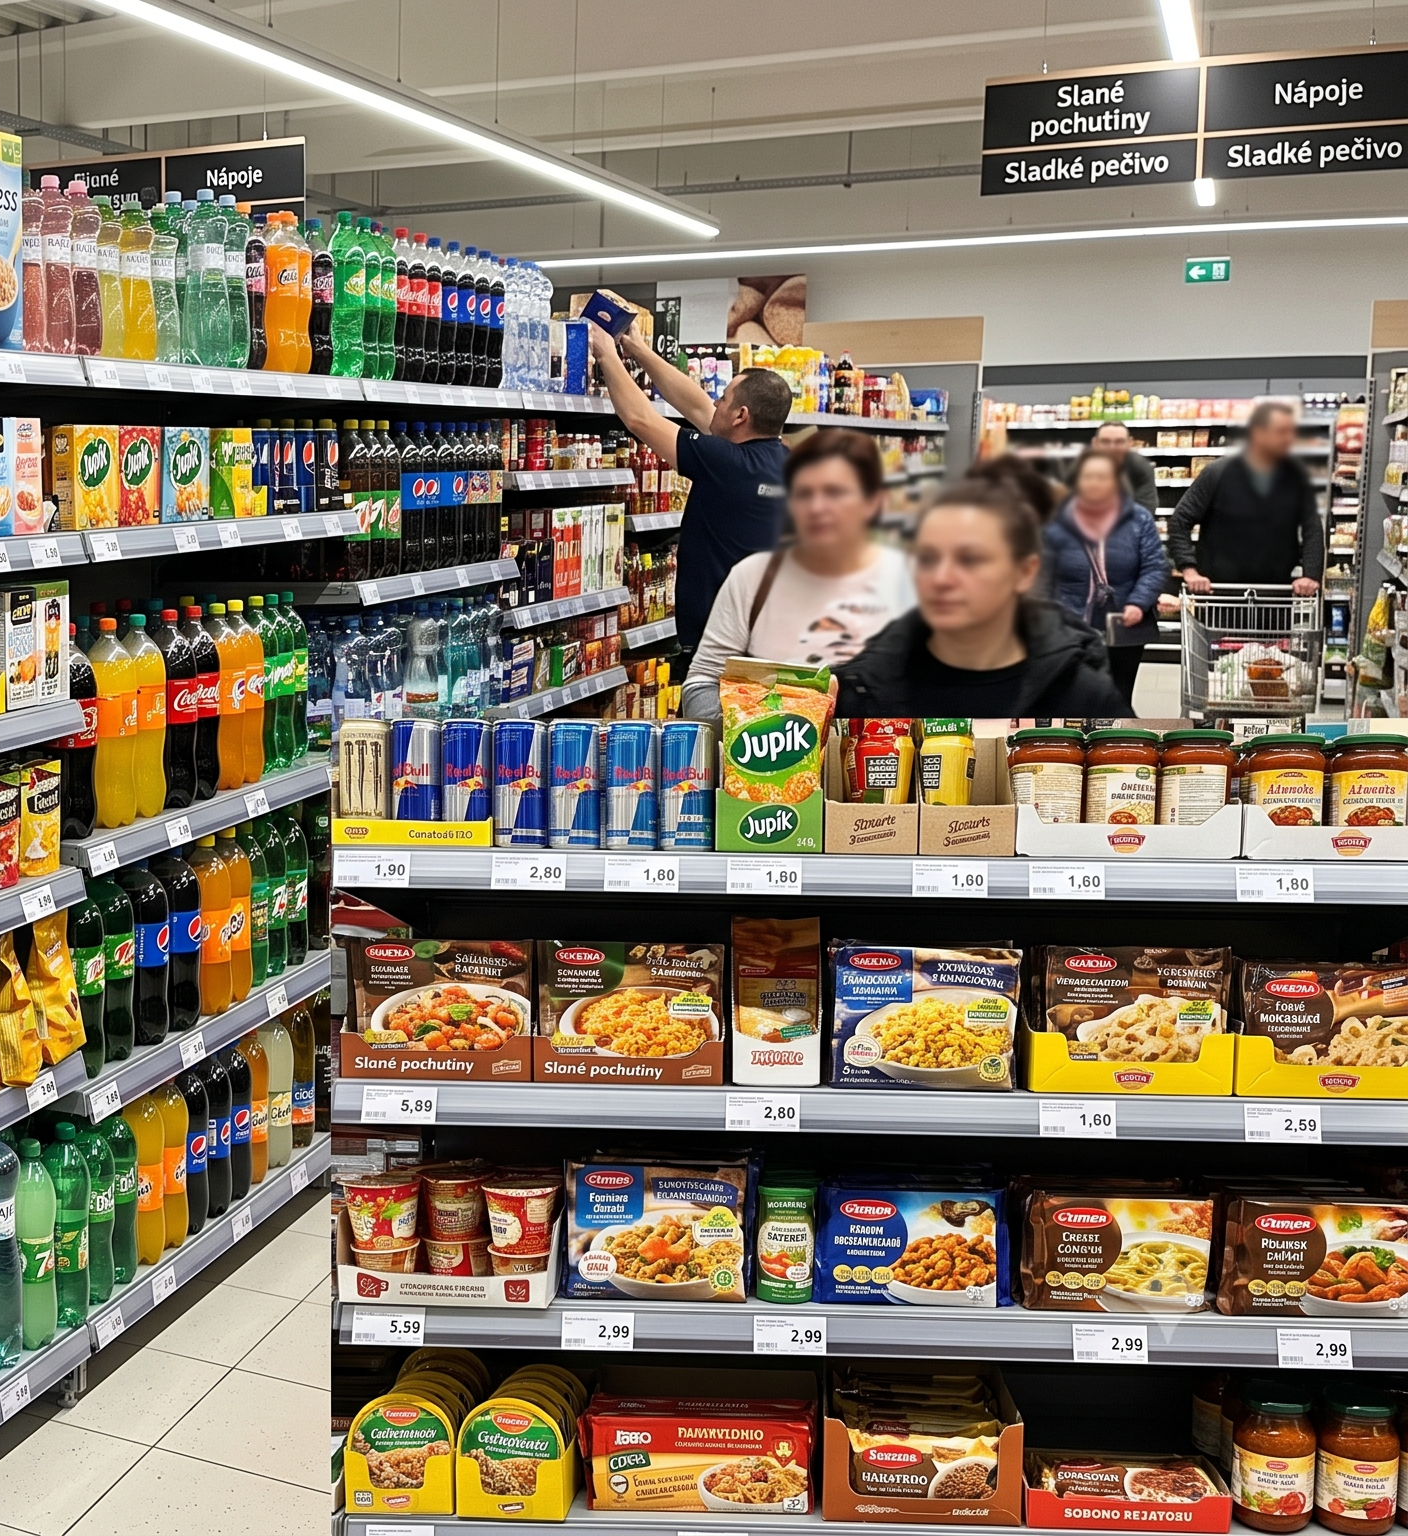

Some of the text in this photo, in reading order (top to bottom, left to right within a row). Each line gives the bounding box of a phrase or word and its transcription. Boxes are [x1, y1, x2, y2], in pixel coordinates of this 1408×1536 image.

[1057, 80, 1124, 107] Slané
[1274, 78, 1363, 108] Nápoje
[1030, 110, 1150, 142] pochutiny
[1227, 141, 1312, 168] Sladké
[1319, 138, 1403, 167] pečivo
[1004, 157, 1084, 184] Sladké
[1090, 153, 1169, 184] pečivo
[206, 166, 263, 189] Nápoje
[737, 719, 812, 763] Jupík
[744, 810, 793, 838] Jupík
[374, 863, 406, 878] 1,90
[529, 866, 562, 880] 2,80
[1067, 875, 1101, 889] 1,60
[355, 1055, 474, 1074] Slané pochutiny
[544, 1060, 662, 1079] Slané pochutiny
[400, 1099, 433, 1113] 5,89
[764, 1106, 795, 1120] 2,80
[1079, 1113, 1112, 1127] 1,60
[1284, 1119, 1317, 1133] 2,59
[598, 1325, 630, 1339] 2,99
[791, 1330, 822, 1344] 2,99
[1111, 1337, 1143, 1352] 2,99
[1316, 1343, 1347, 1357] 2,99
[1064, 1507, 1121, 1520] SOBONO
